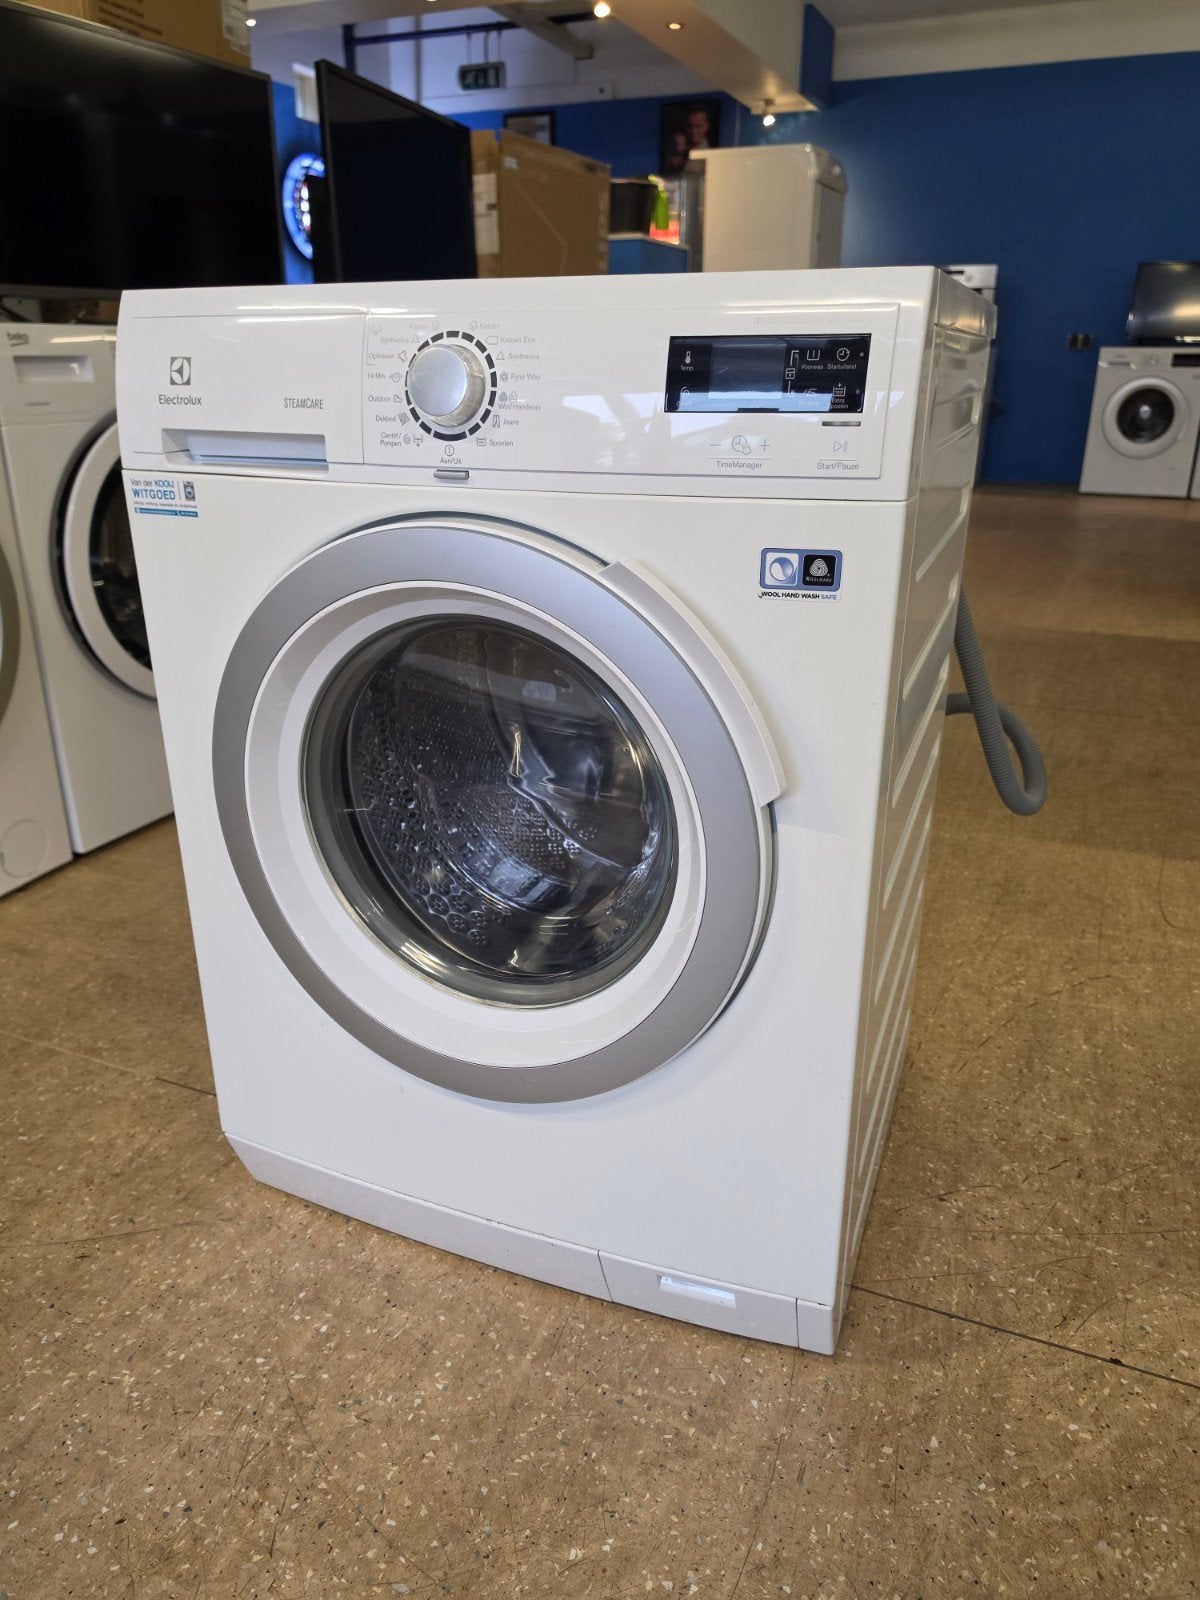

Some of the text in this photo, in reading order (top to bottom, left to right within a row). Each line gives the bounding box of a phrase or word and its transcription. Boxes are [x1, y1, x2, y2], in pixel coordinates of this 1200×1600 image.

[380, 336, 409, 344] Synthetica
[508, 352, 540, 361] Synthetica
[158, 394, 202, 406] Electrolux
[368, 394, 391, 402] Outdoor
[284, 397, 324, 410] STEAMCARE
[498, 402, 541, 411] Wol/Handwas
[380, 439, 402, 448] Pompen
[488, 439, 514, 448] Spoelen
[716, 460, 762, 470] TimeManager
[816, 462, 860, 470] Start/Pauze
[130, 478, 142, 486] Van
[142, 479, 152, 487] der
[132, 488, 176, 500] WITGOED
